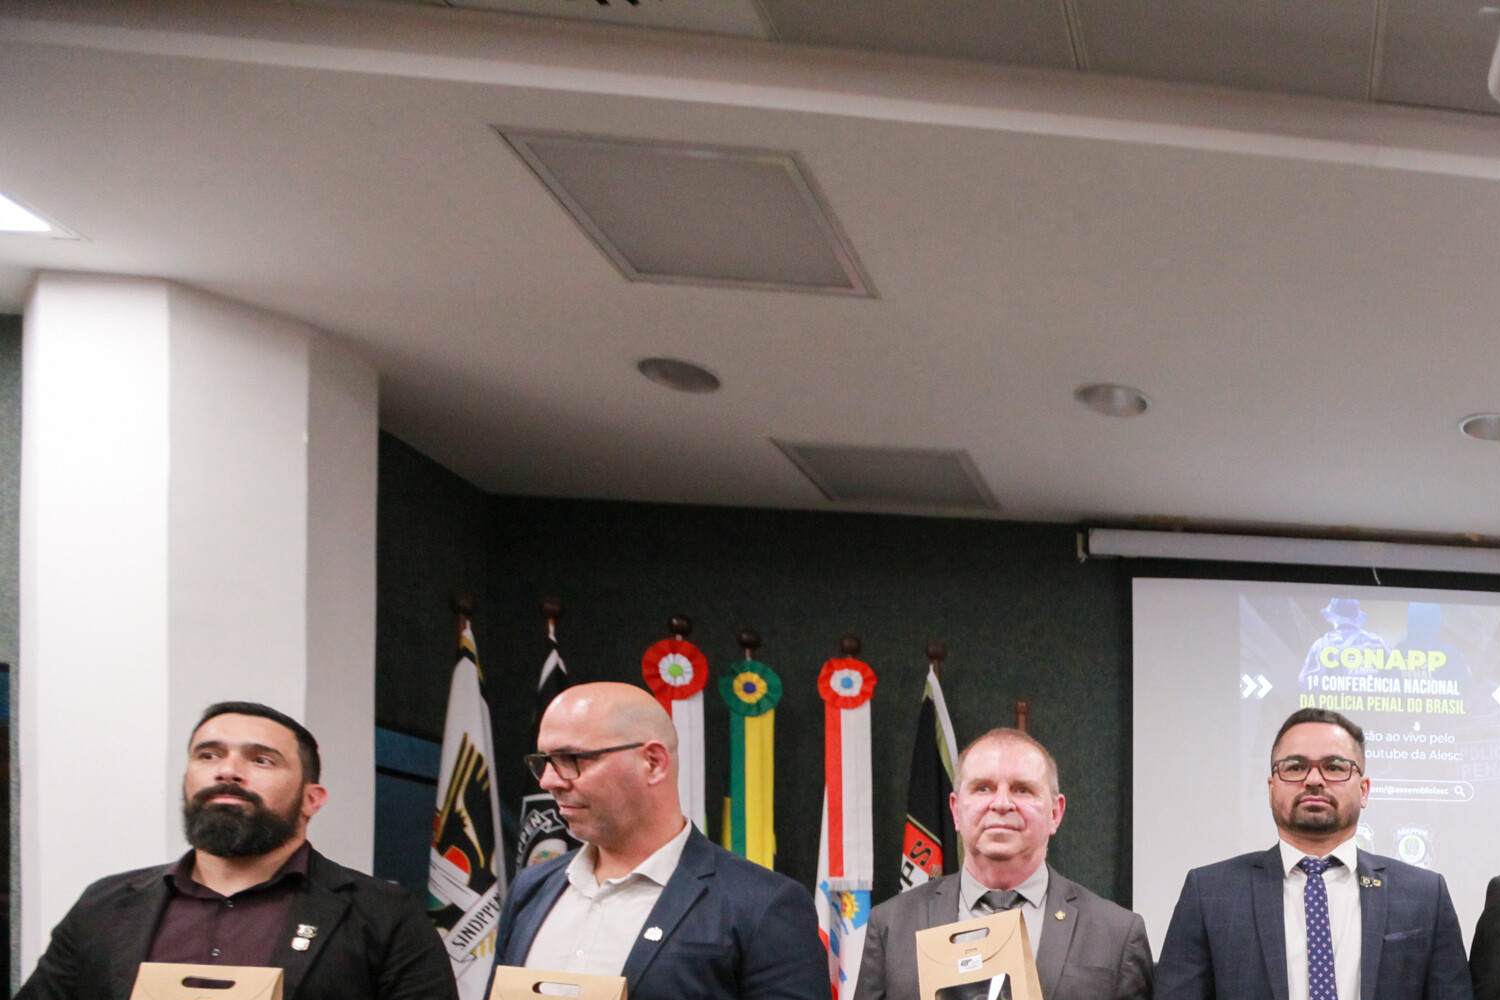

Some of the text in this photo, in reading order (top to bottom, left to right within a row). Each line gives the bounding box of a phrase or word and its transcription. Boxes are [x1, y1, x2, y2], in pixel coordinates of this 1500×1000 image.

[1319, 646, 1448, 672] CONAPP
[1307, 674, 1461, 696] 1ª CONFERÊNCIA NACIONAL
[1299, 693, 1467, 715] DA POLÍCIA PENAL DO BRASIL
[1364, 731, 1456, 745] são ao vivo pelo
[1365, 749, 1464, 761] outube da Alesc:
[1370, 784, 1450, 796] om/@assembleiasc
